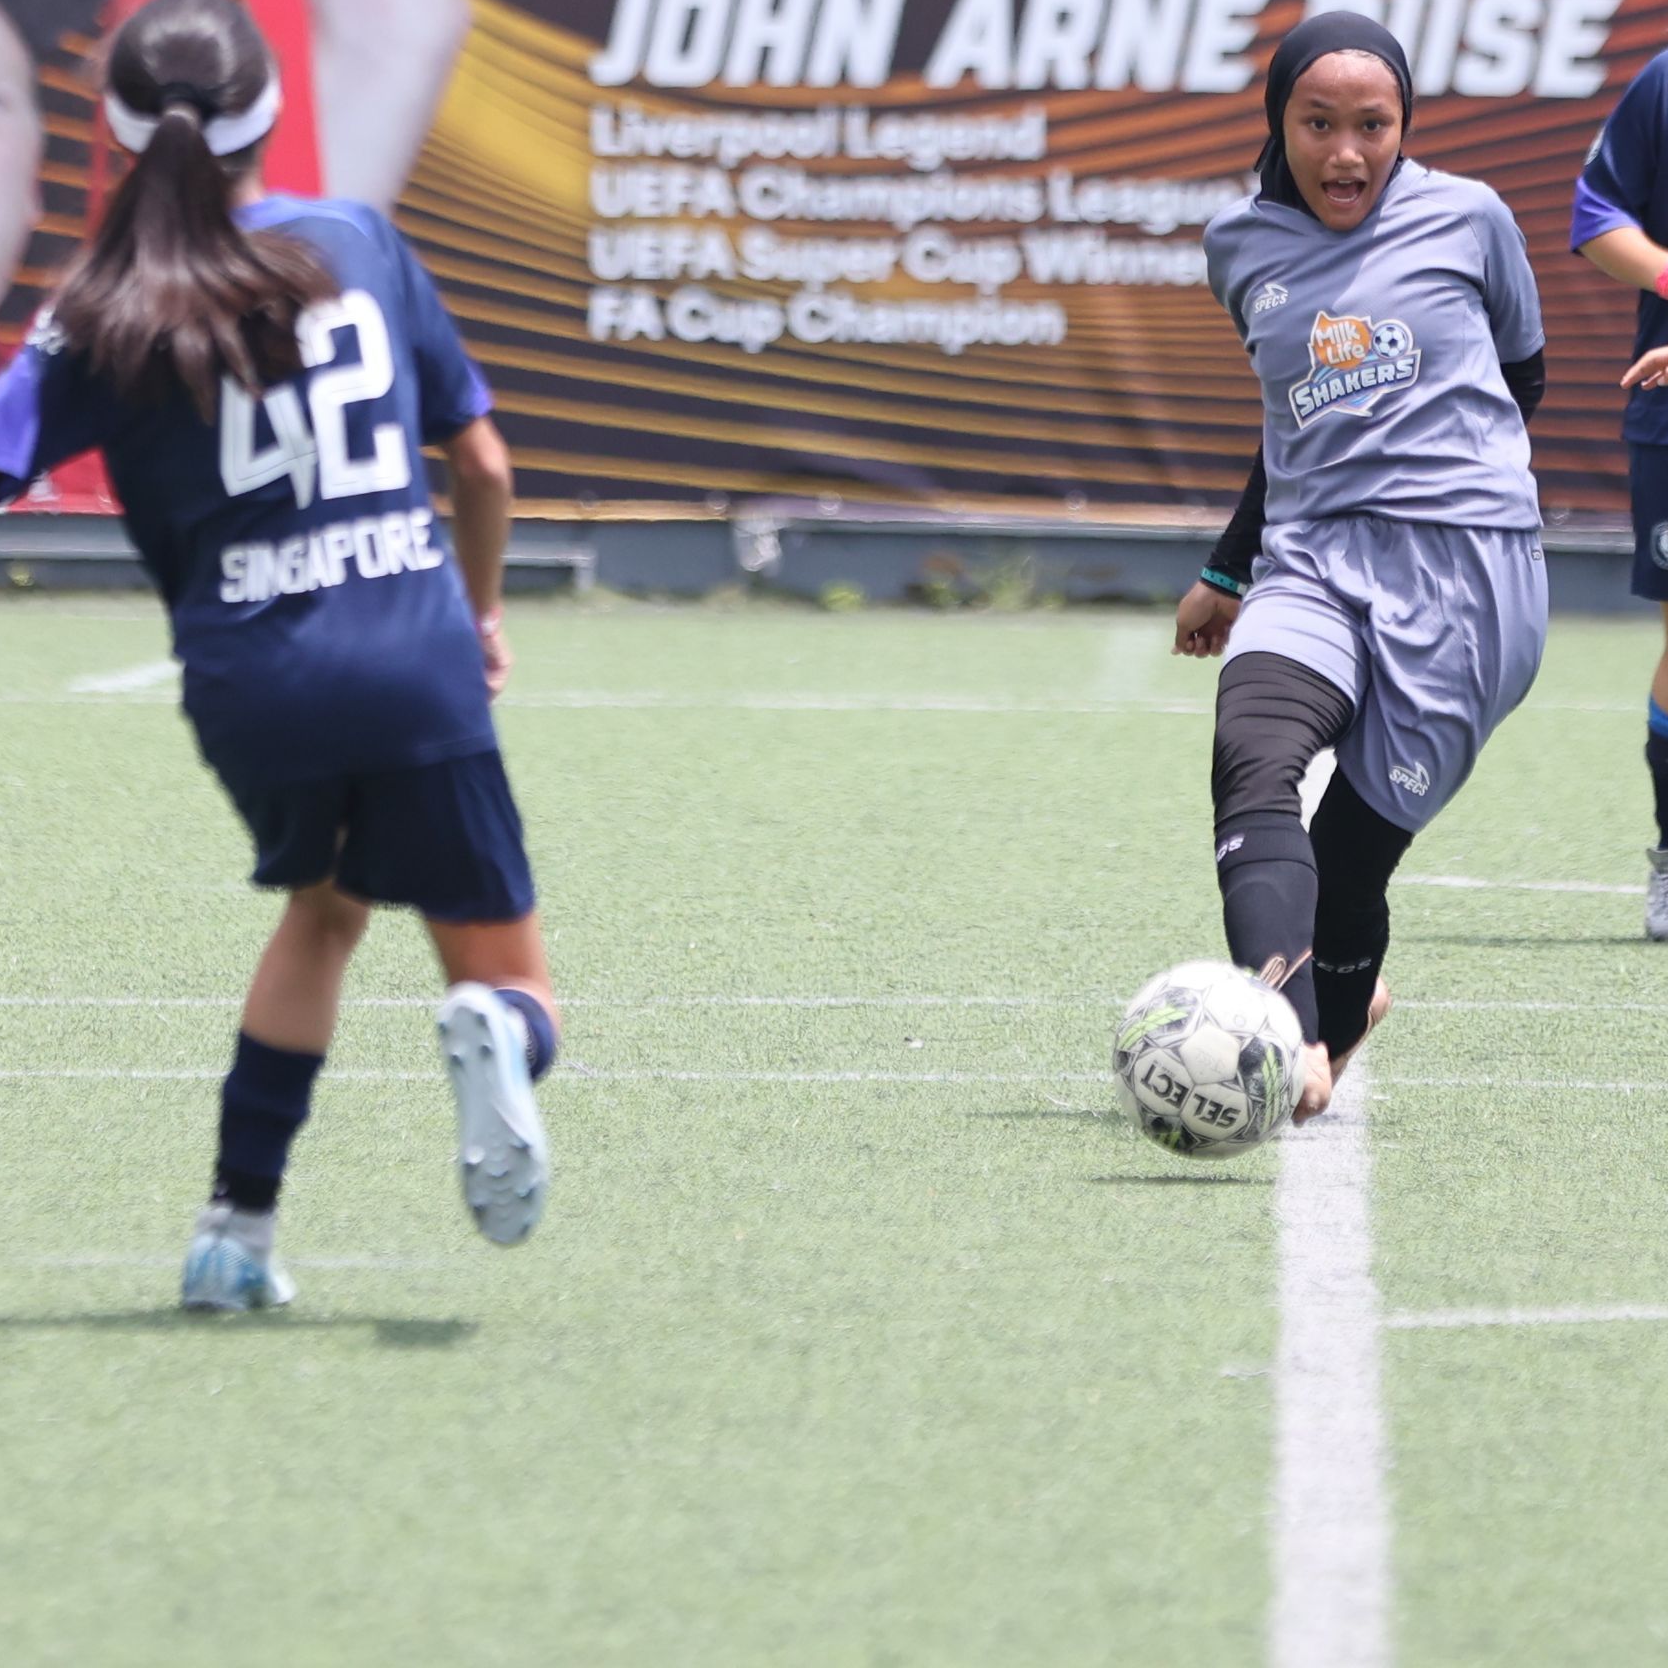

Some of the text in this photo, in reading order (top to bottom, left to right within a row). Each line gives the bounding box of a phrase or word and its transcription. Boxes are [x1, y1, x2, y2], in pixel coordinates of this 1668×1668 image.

[589, 100, 1047, 173] Liverpool Legend
[589, 164, 735, 218] UEFA
[737, 164, 1045, 233] Champions
[588, 221, 735, 279] UEFA
[738, 224, 898, 294] Super
[900, 228, 1024, 298] Cup
[587, 286, 1068, 356] FA Cup Champion
[1254, 292, 1289, 314] SPECS
[1315, 319, 1361, 347] Milk
[1294, 357, 1415, 418] SHAKERS
[1326, 342, 1366, 366] Life
[220, 288, 412, 510] 42
[219, 507, 445, 603] SINGAPORE
[1389, 767, 1430, 797] SPECS
[1140, 1064, 1241, 1129] SELECT
